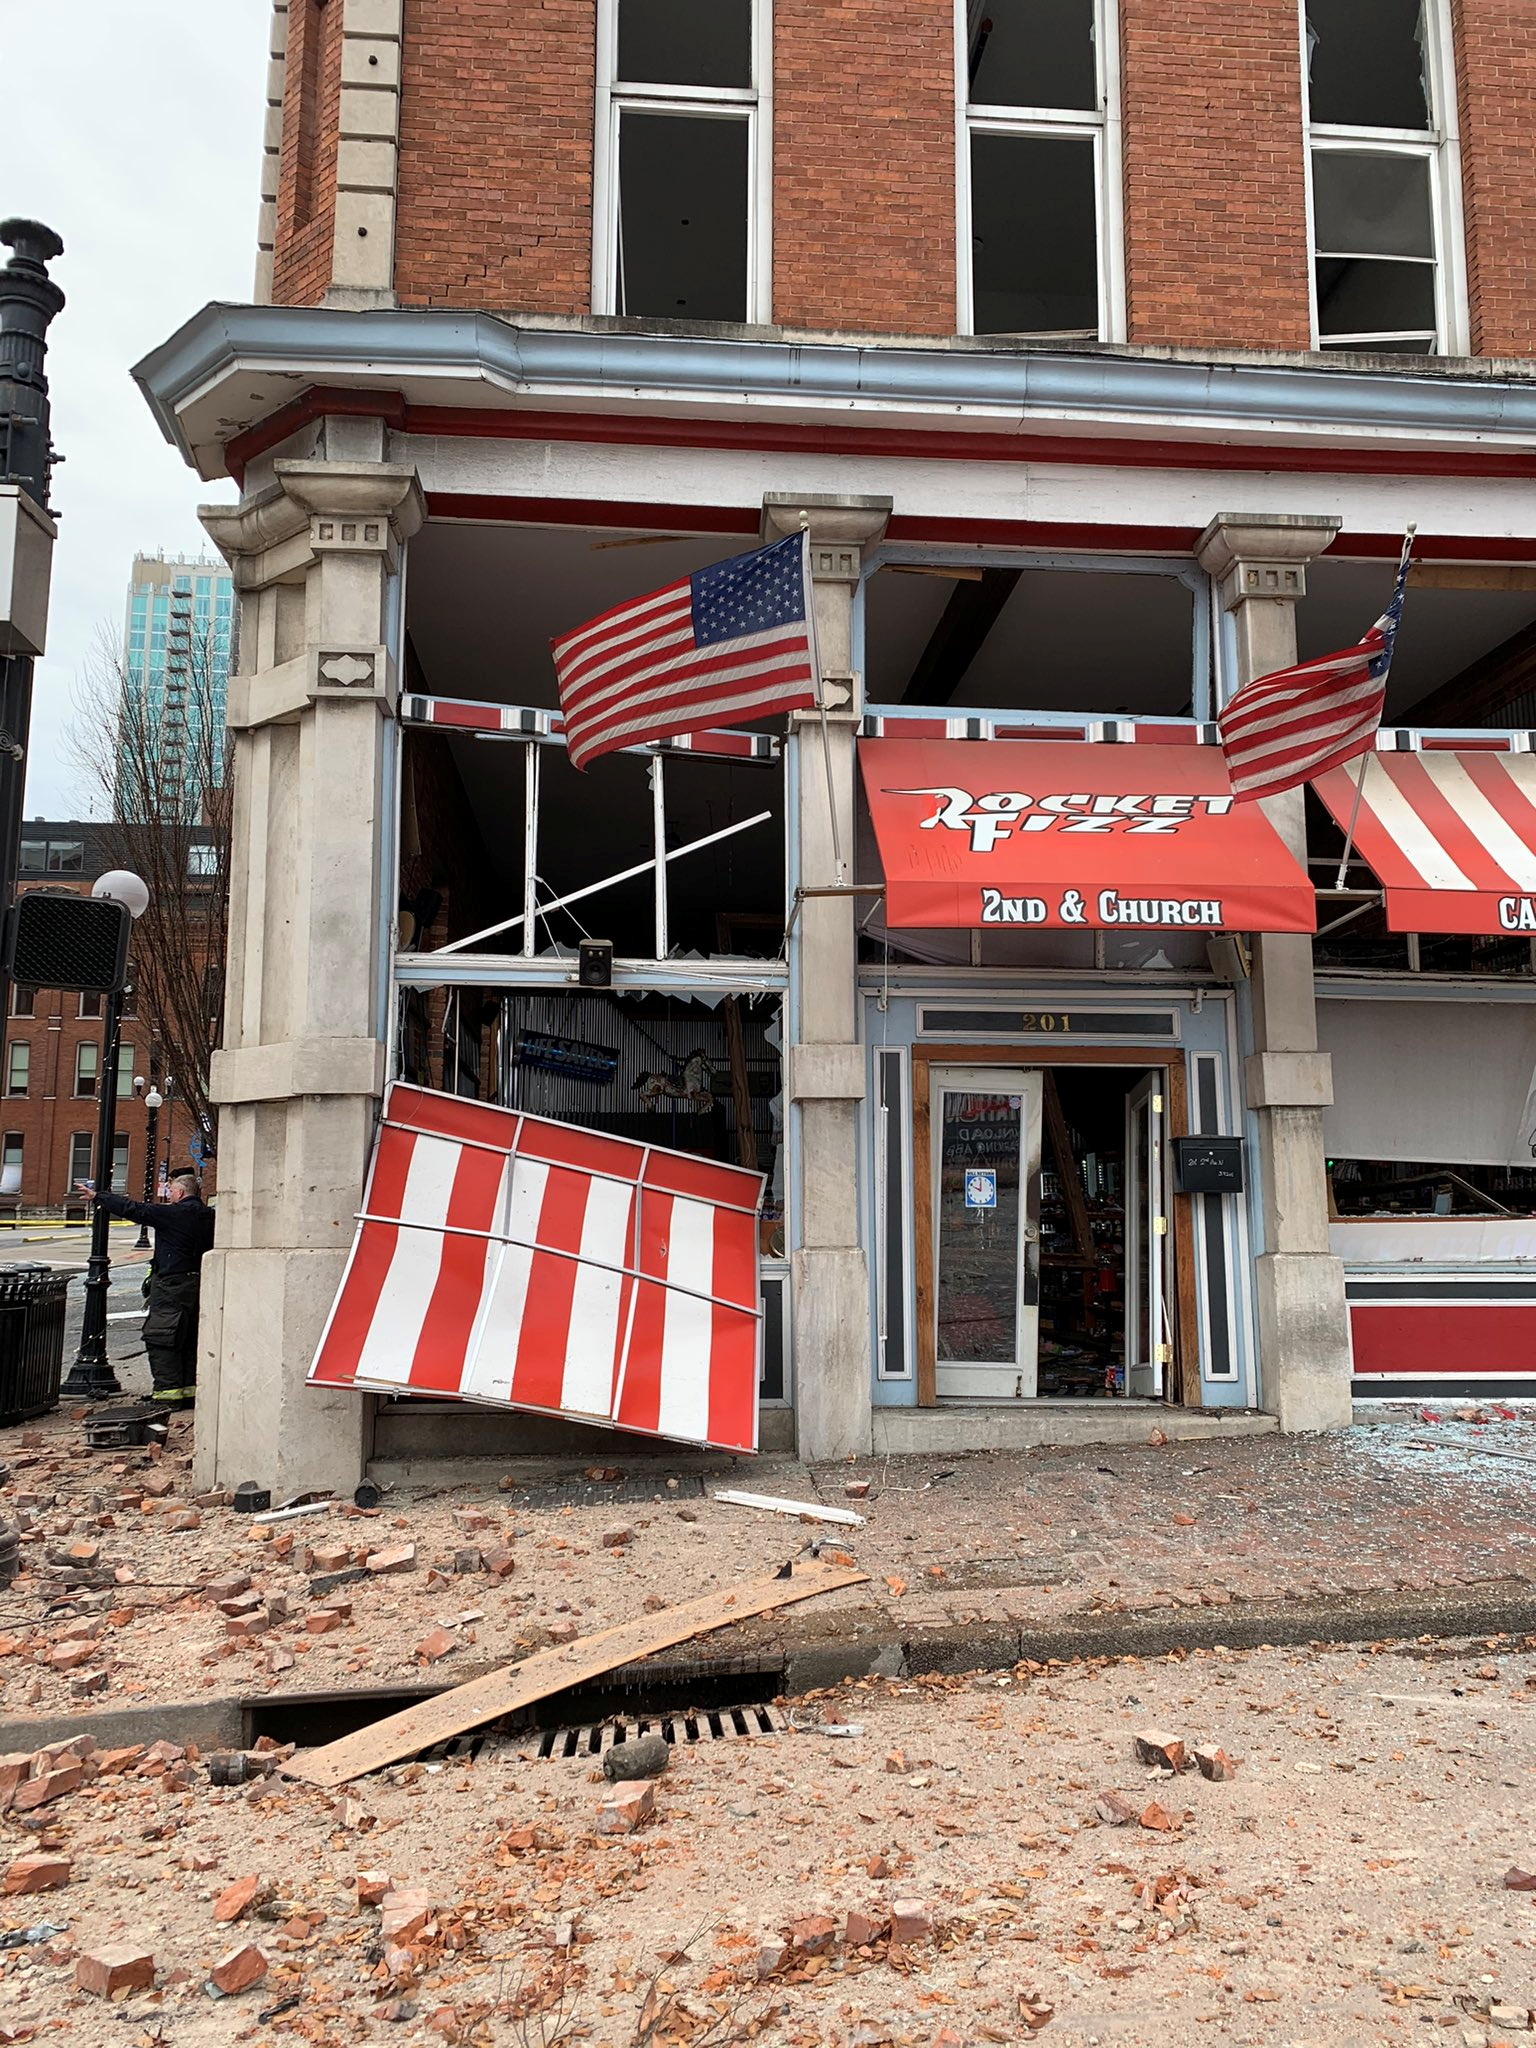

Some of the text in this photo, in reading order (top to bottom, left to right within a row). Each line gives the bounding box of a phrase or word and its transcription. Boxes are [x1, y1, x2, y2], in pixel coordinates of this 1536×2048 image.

[881, 787, 1234, 830] ROCKET
[967, 812, 1194, 852] FIZZ
[1060, 890, 1087, 924] &
[1022, 1013, 1071, 1032] 201
[525, 1039, 556, 1059] LIFE
